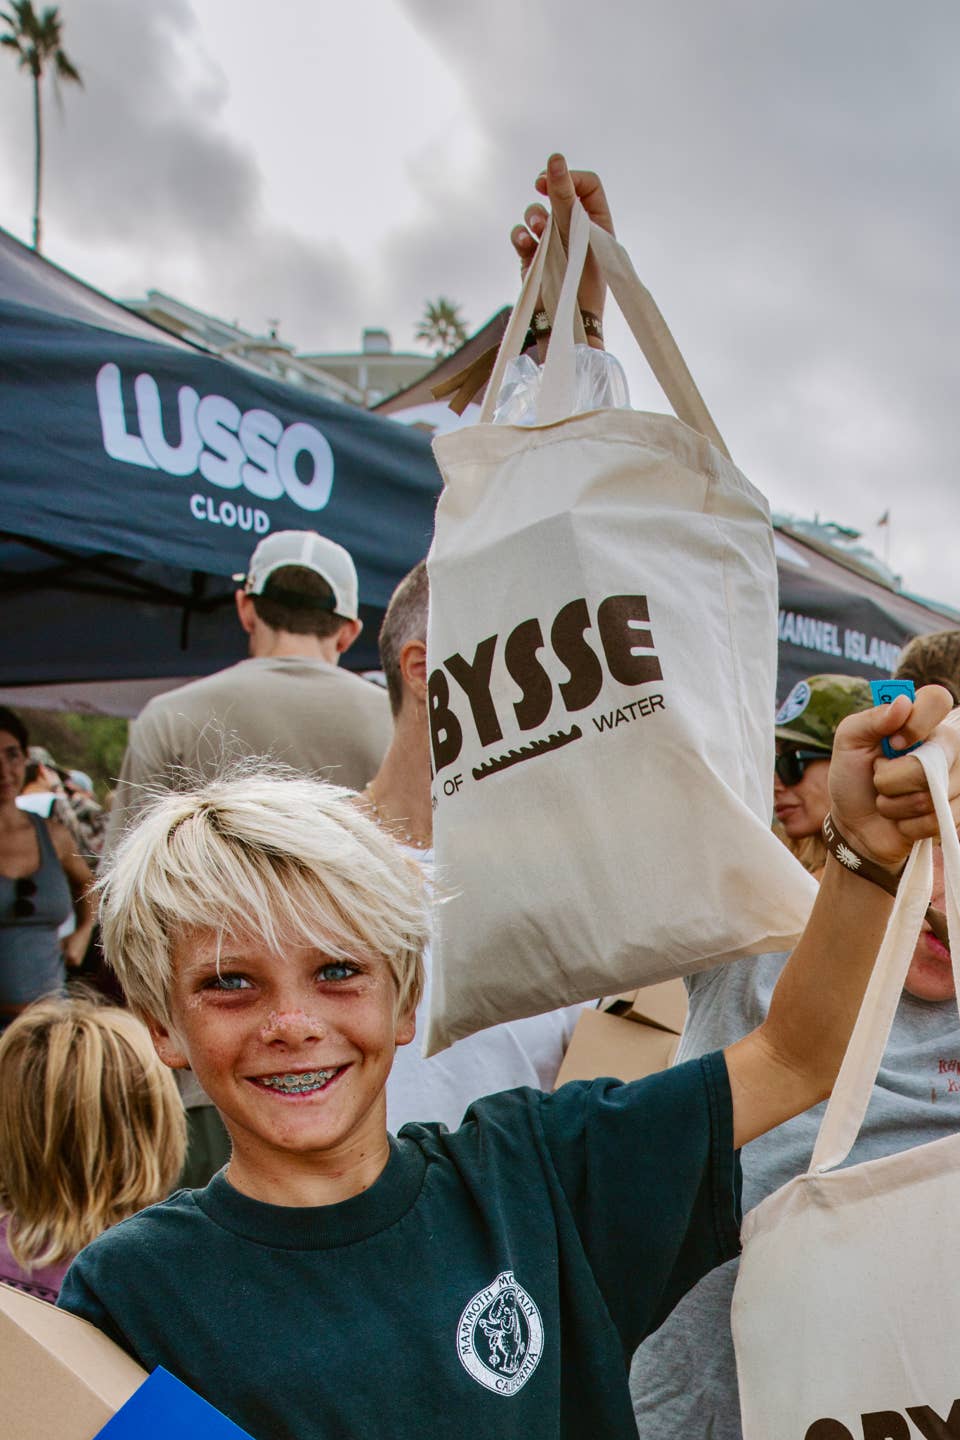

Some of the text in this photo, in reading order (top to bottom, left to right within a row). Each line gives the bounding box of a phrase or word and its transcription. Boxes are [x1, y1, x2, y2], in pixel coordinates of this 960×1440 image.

[96, 362, 335, 512] LUSSO
[190, 494, 270, 534] CLOUD
[429, 595, 664, 774] BYSSE
[443, 694, 665, 796] OF WATER
[460, 1290, 493, 1355] MAMMOTH
